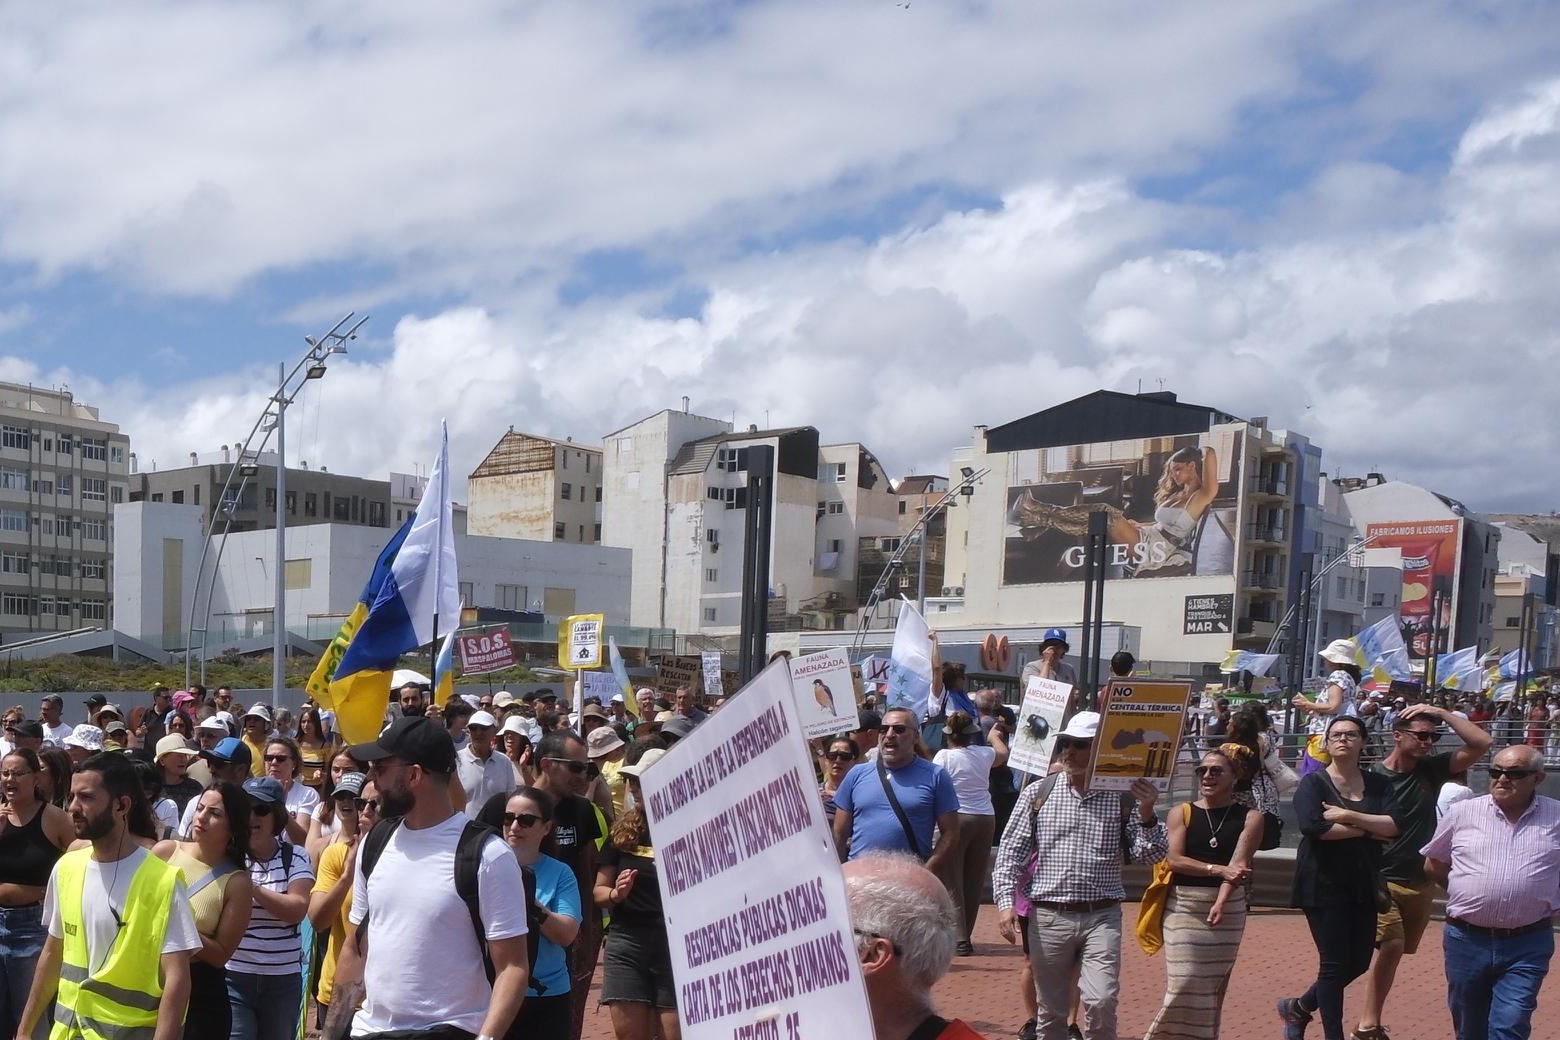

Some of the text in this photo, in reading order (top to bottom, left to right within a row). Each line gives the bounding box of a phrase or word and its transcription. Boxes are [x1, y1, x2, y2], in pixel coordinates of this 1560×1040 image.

[1370, 524, 1454, 536] FABRICAMOS ILUSIONES
[1065, 541, 1166, 567] GESS
[1187, 621, 1213, 632] MAR
[467, 633, 508, 655] S.O.S.
[794, 658, 845, 676] AMENAZADA
[806, 653, 829, 663] FAUNA
[1028, 687, 1065, 703] AMENAZADA
[1113, 687, 1133, 697] NO
[1109, 703, 1146, 711] CENTRAL
[668, 774, 689, 812] ROBO
[686, 767, 698, 801] DE
[693, 761, 707, 797] LA
[702, 752, 718, 789] LEY
[713, 746, 728, 781] DE
[722, 740, 737, 774] LA
[731, 705, 783, 768] DEPENDENCIA
[779, 700, 790, 740] A
[662, 831, 703, 897] NUESTRAS
[695, 811, 738, 881] MAYORES
[730, 806, 744, 862] Y
[684, 876, 827, 969] RESIDENCIAS PÚBLICAS DIGNAS
[683, 930, 850, 1027] CARTA DE LOS DERECHOS HUMANOS
